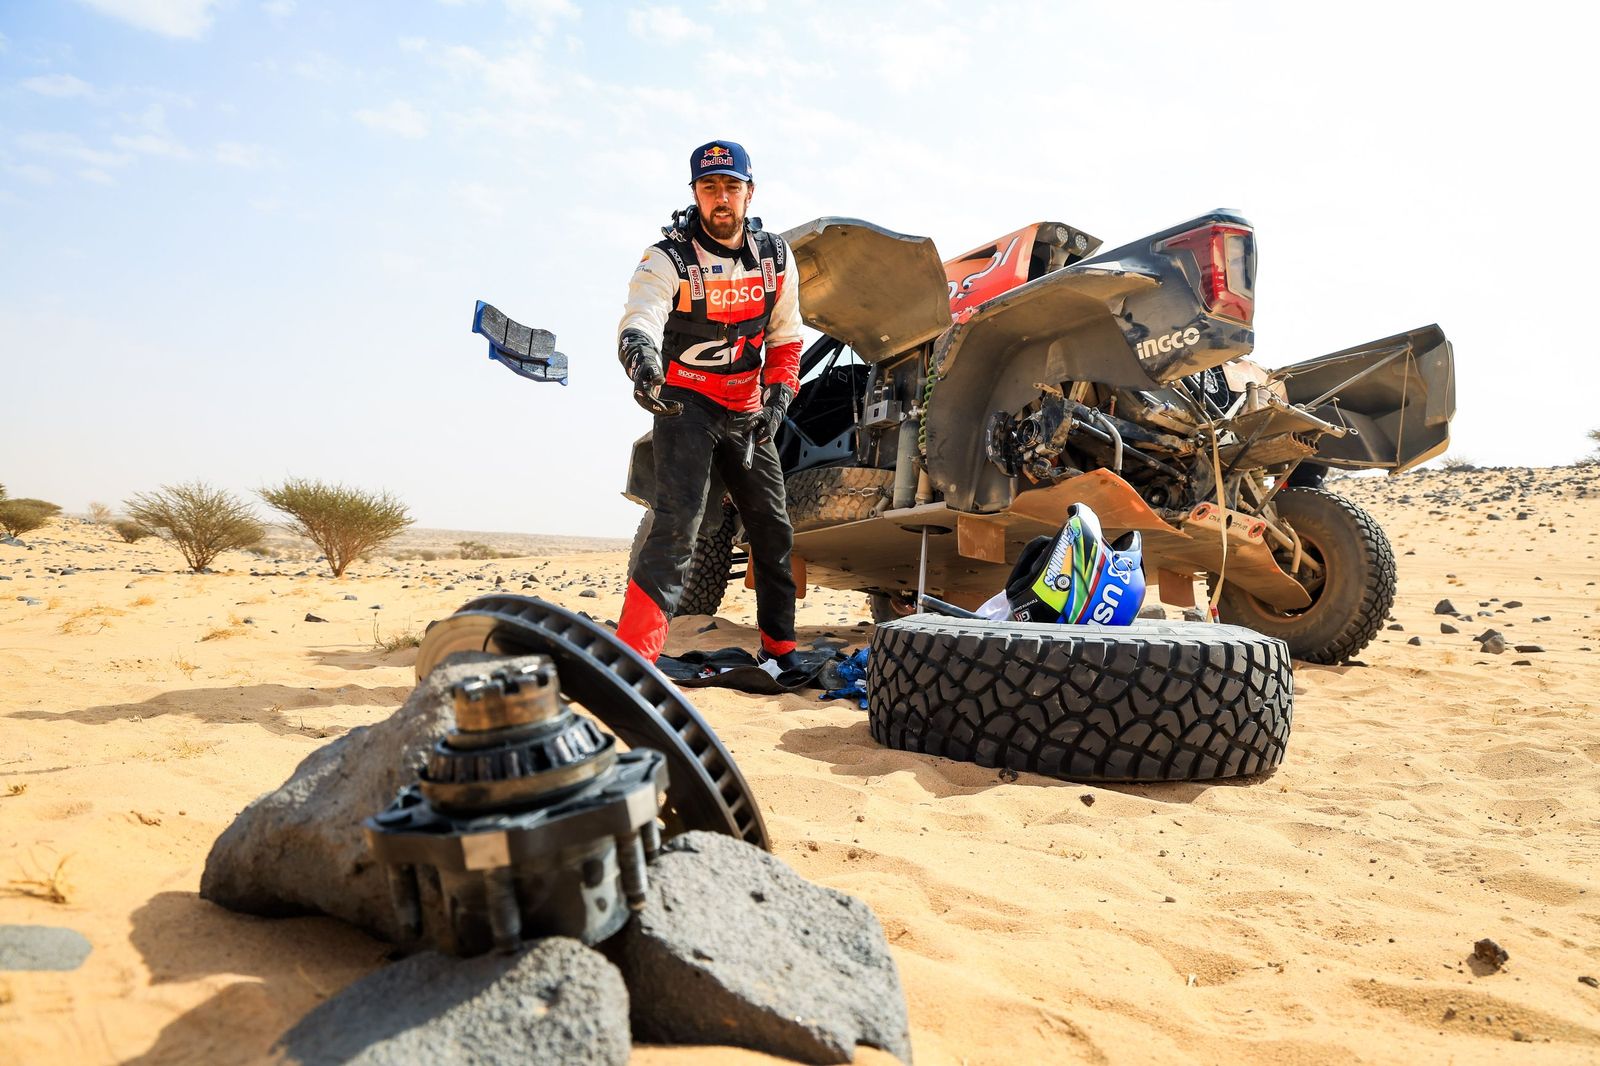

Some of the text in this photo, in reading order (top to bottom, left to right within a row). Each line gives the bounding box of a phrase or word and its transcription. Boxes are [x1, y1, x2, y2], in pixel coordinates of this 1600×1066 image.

[700, 156, 734, 168] Red Bull
[667, 248, 686, 273] sparco
[690, 269, 702, 296] SIMPSON
[763, 262, 773, 287] SIMPSON
[706, 285, 764, 309] epso
